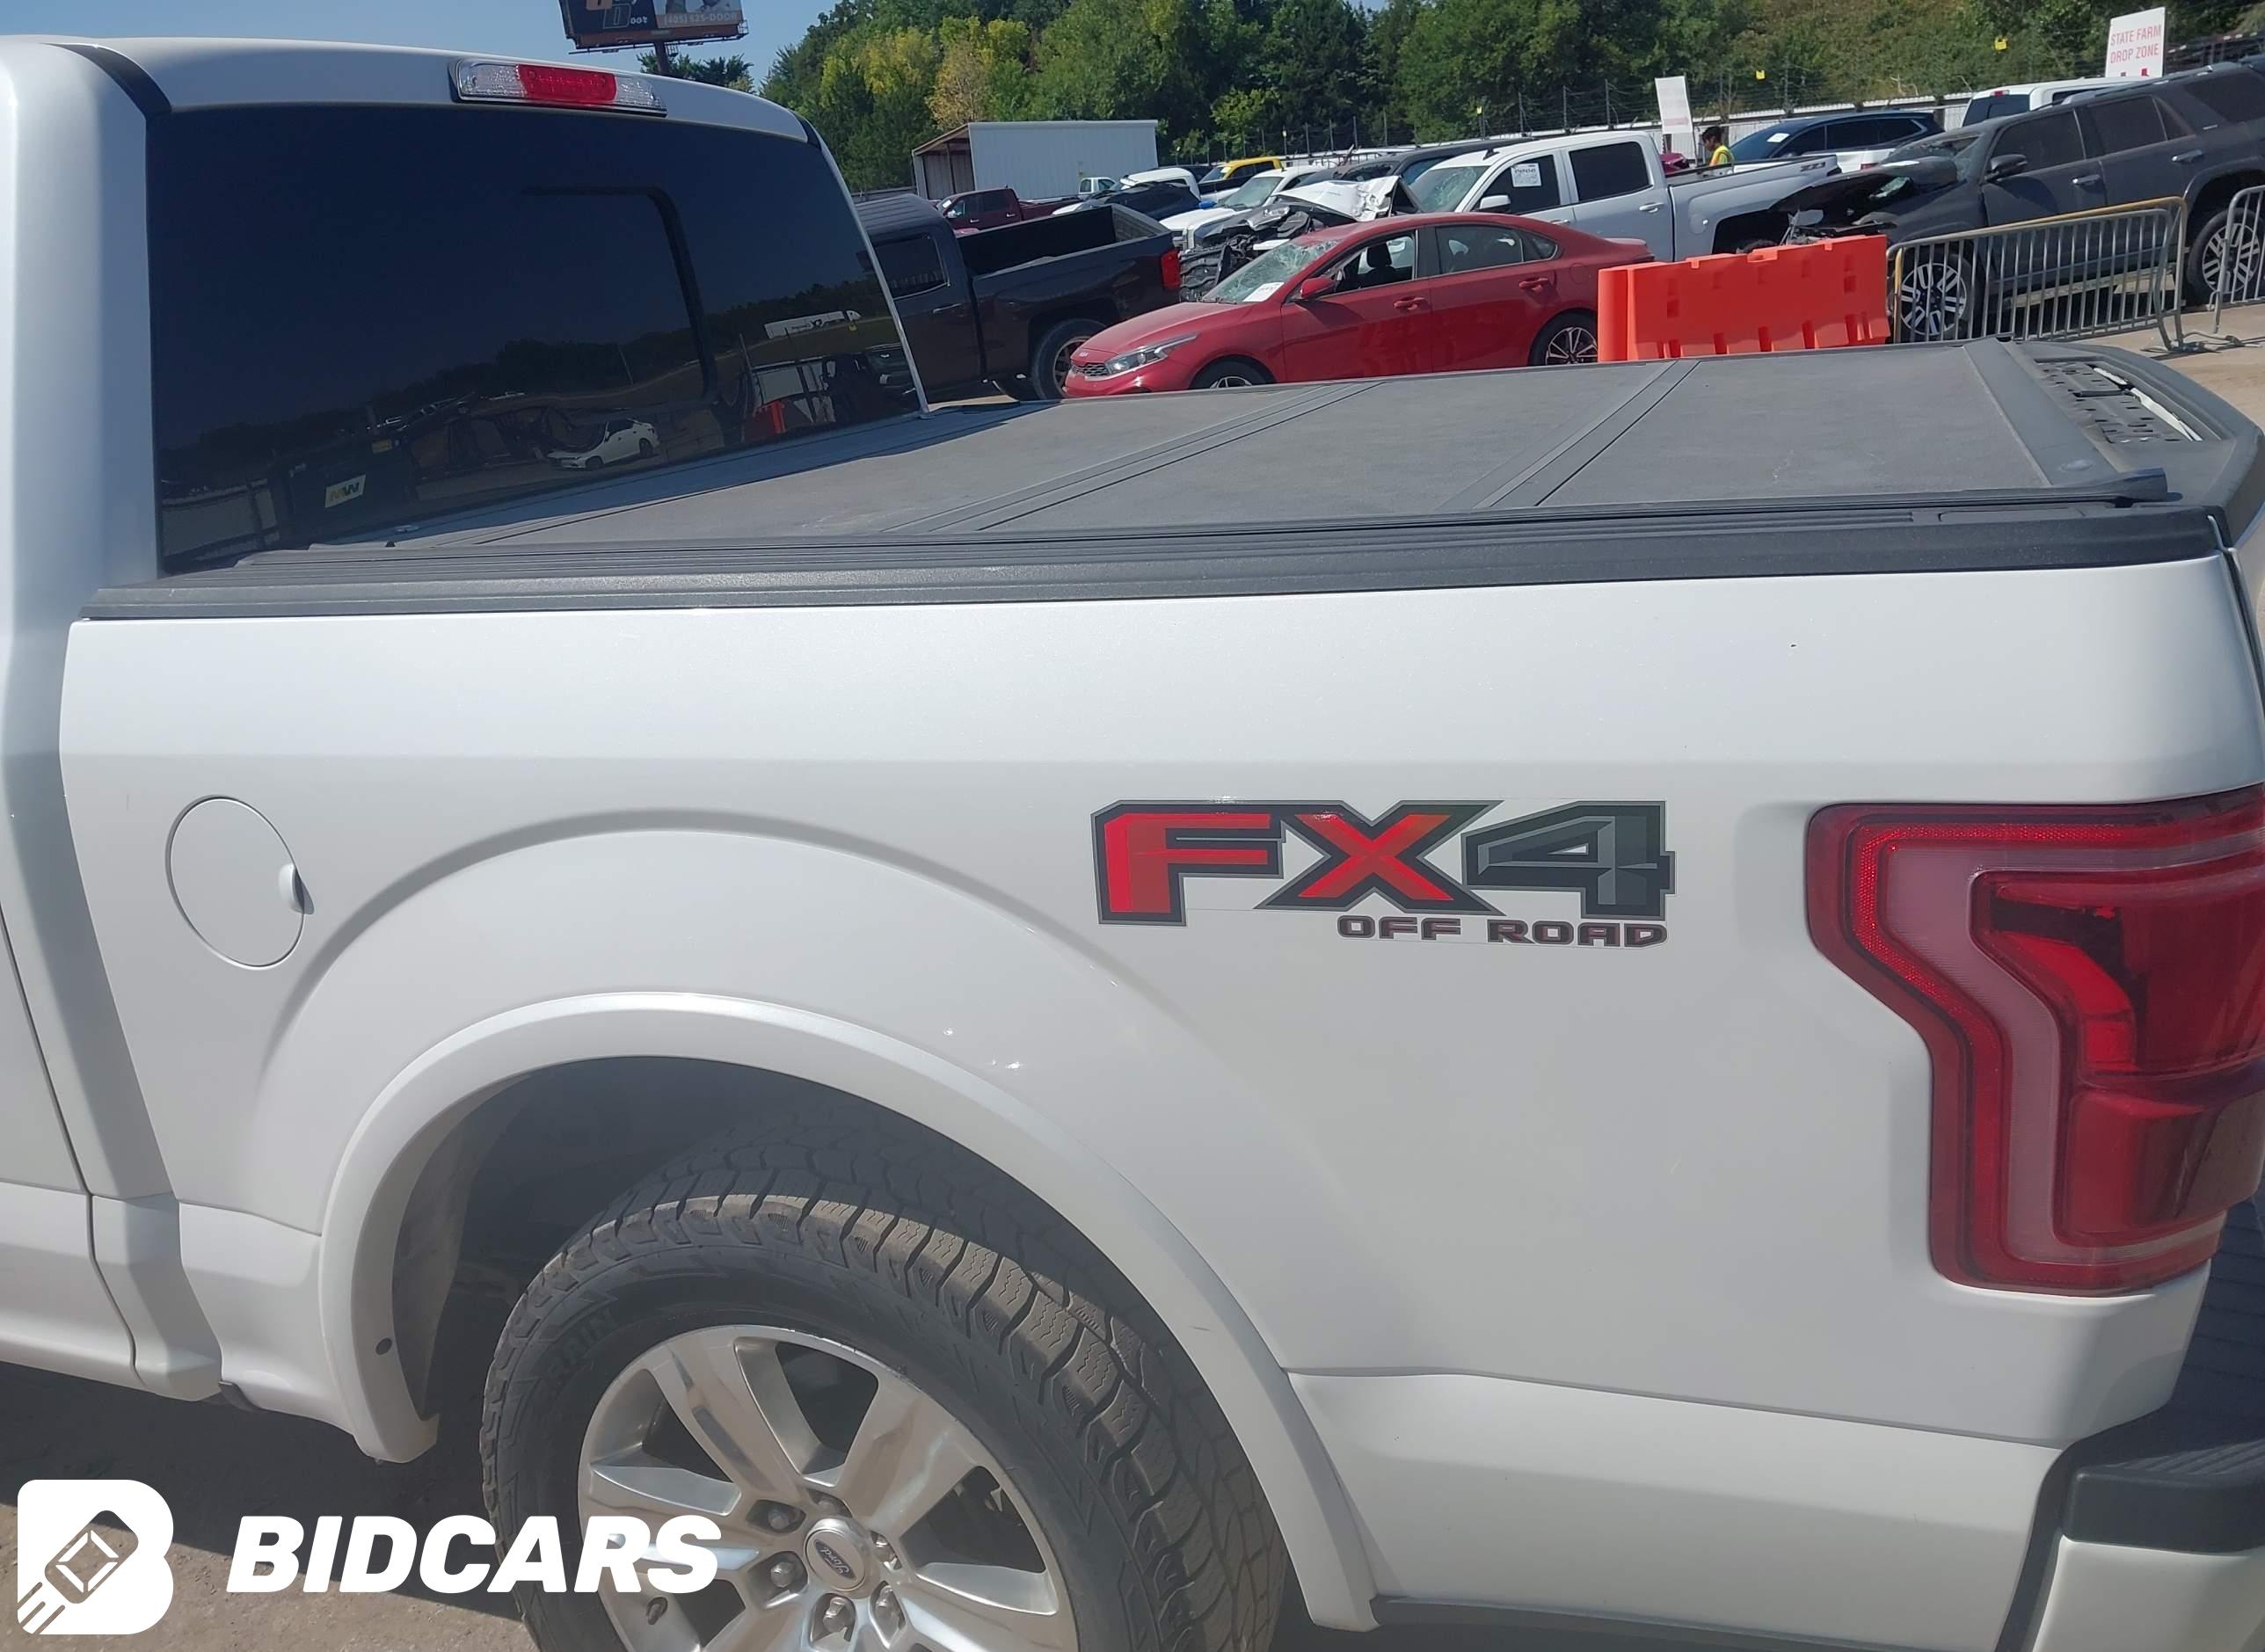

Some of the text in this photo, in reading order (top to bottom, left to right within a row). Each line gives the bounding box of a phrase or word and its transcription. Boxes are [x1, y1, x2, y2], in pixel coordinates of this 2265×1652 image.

[2111, 25, 2161, 46] STATE FARM
[2110, 43, 2159, 64] DROP ZONE
[1091, 799, 1676, 928] FX4
[1337, 915, 1668, 949] OFF ROAD
[819, 1546, 849, 1575] Ford
